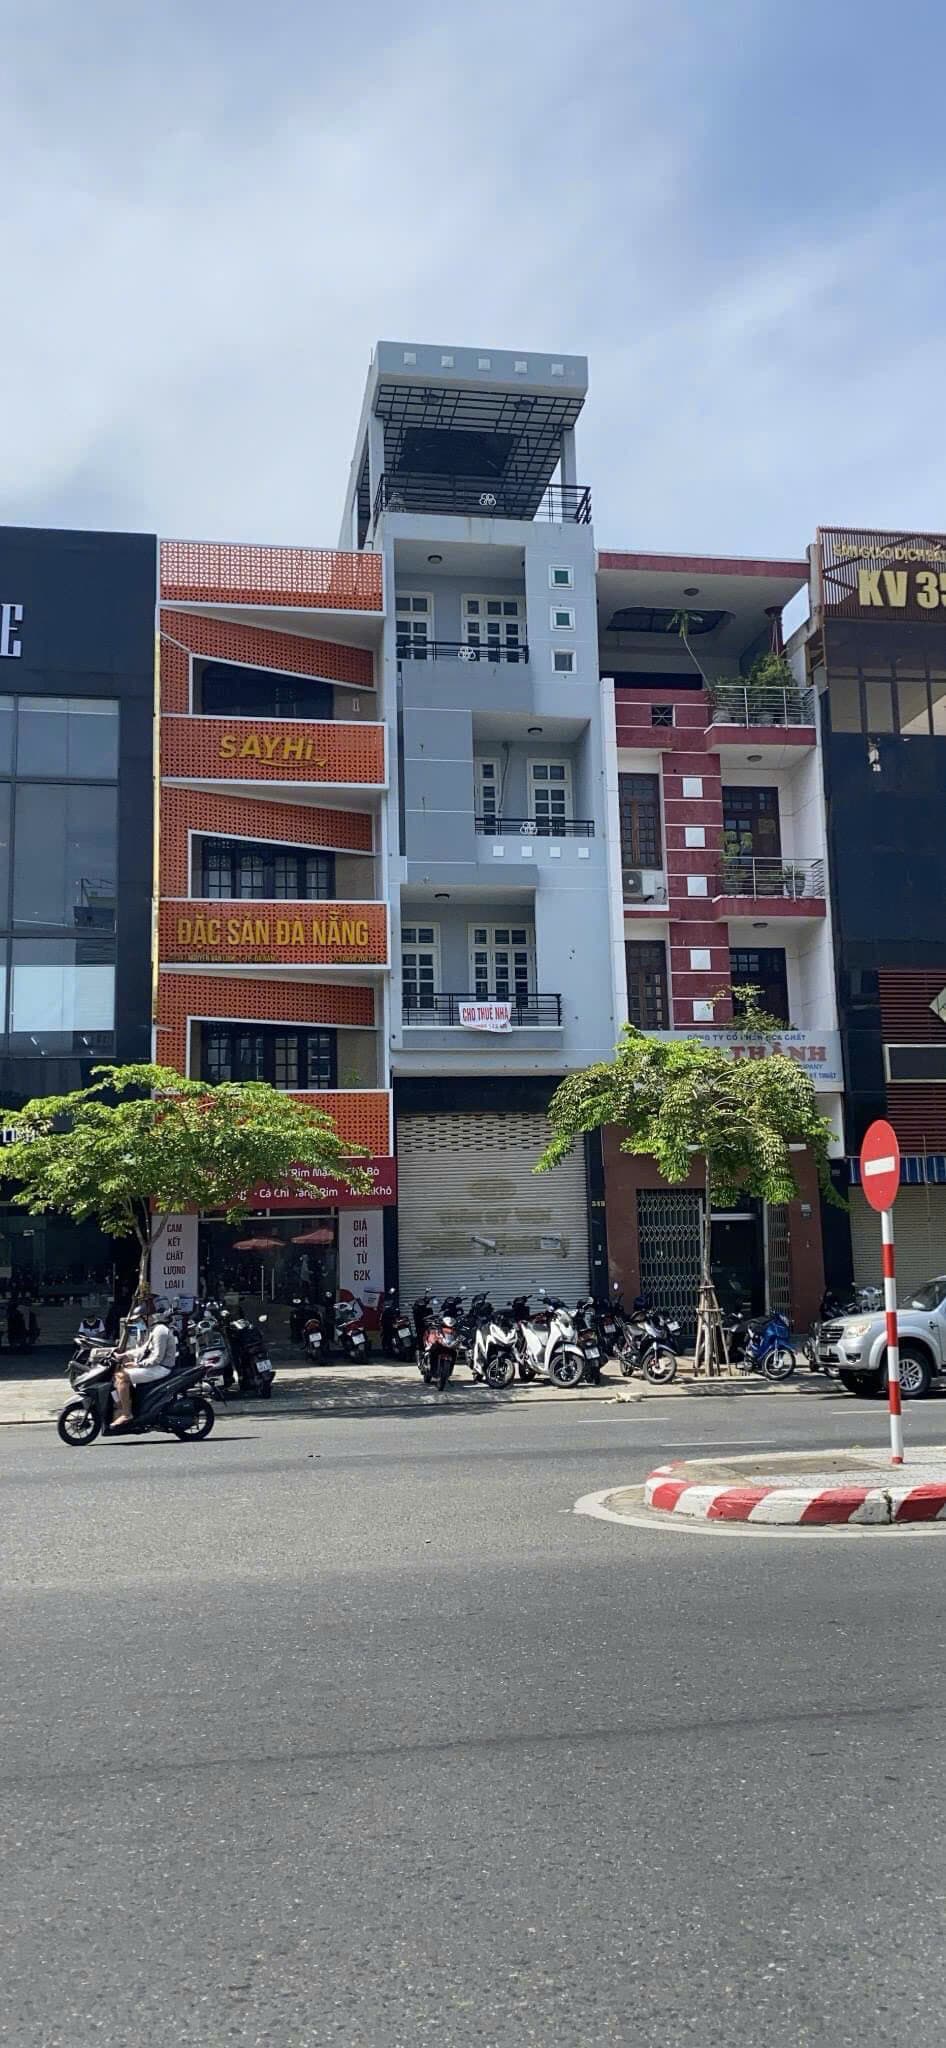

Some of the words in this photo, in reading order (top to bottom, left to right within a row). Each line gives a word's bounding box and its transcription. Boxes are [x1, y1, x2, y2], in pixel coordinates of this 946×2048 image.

[895, 547, 925, 563] DỊCH
[858, 570, 908, 607] KV
[219, 734, 315, 760] SAYHi
[177, 913, 220, 948] ĐẶC
[227, 912, 270, 945] SẢN
[276, 915, 305, 946] ĐÀ
[312, 911, 369, 946] NẴNG
[463, 1007, 476, 1021] CHO
[478, 1004, 494, 1020] THUÊ
[730, 1041, 826, 1061] THÀNH
[373, 1185, 392, 1196] Khô
[166, 1223, 183, 1233] CAM
[353, 1218, 368, 1232] GIÁ
[167, 1236, 181, 1247] KẾT
[353, 1234, 368, 1248] CHỈ
[165, 1251, 184, 1261] CHẤT
[353, 1269, 371, 1281] 62K
